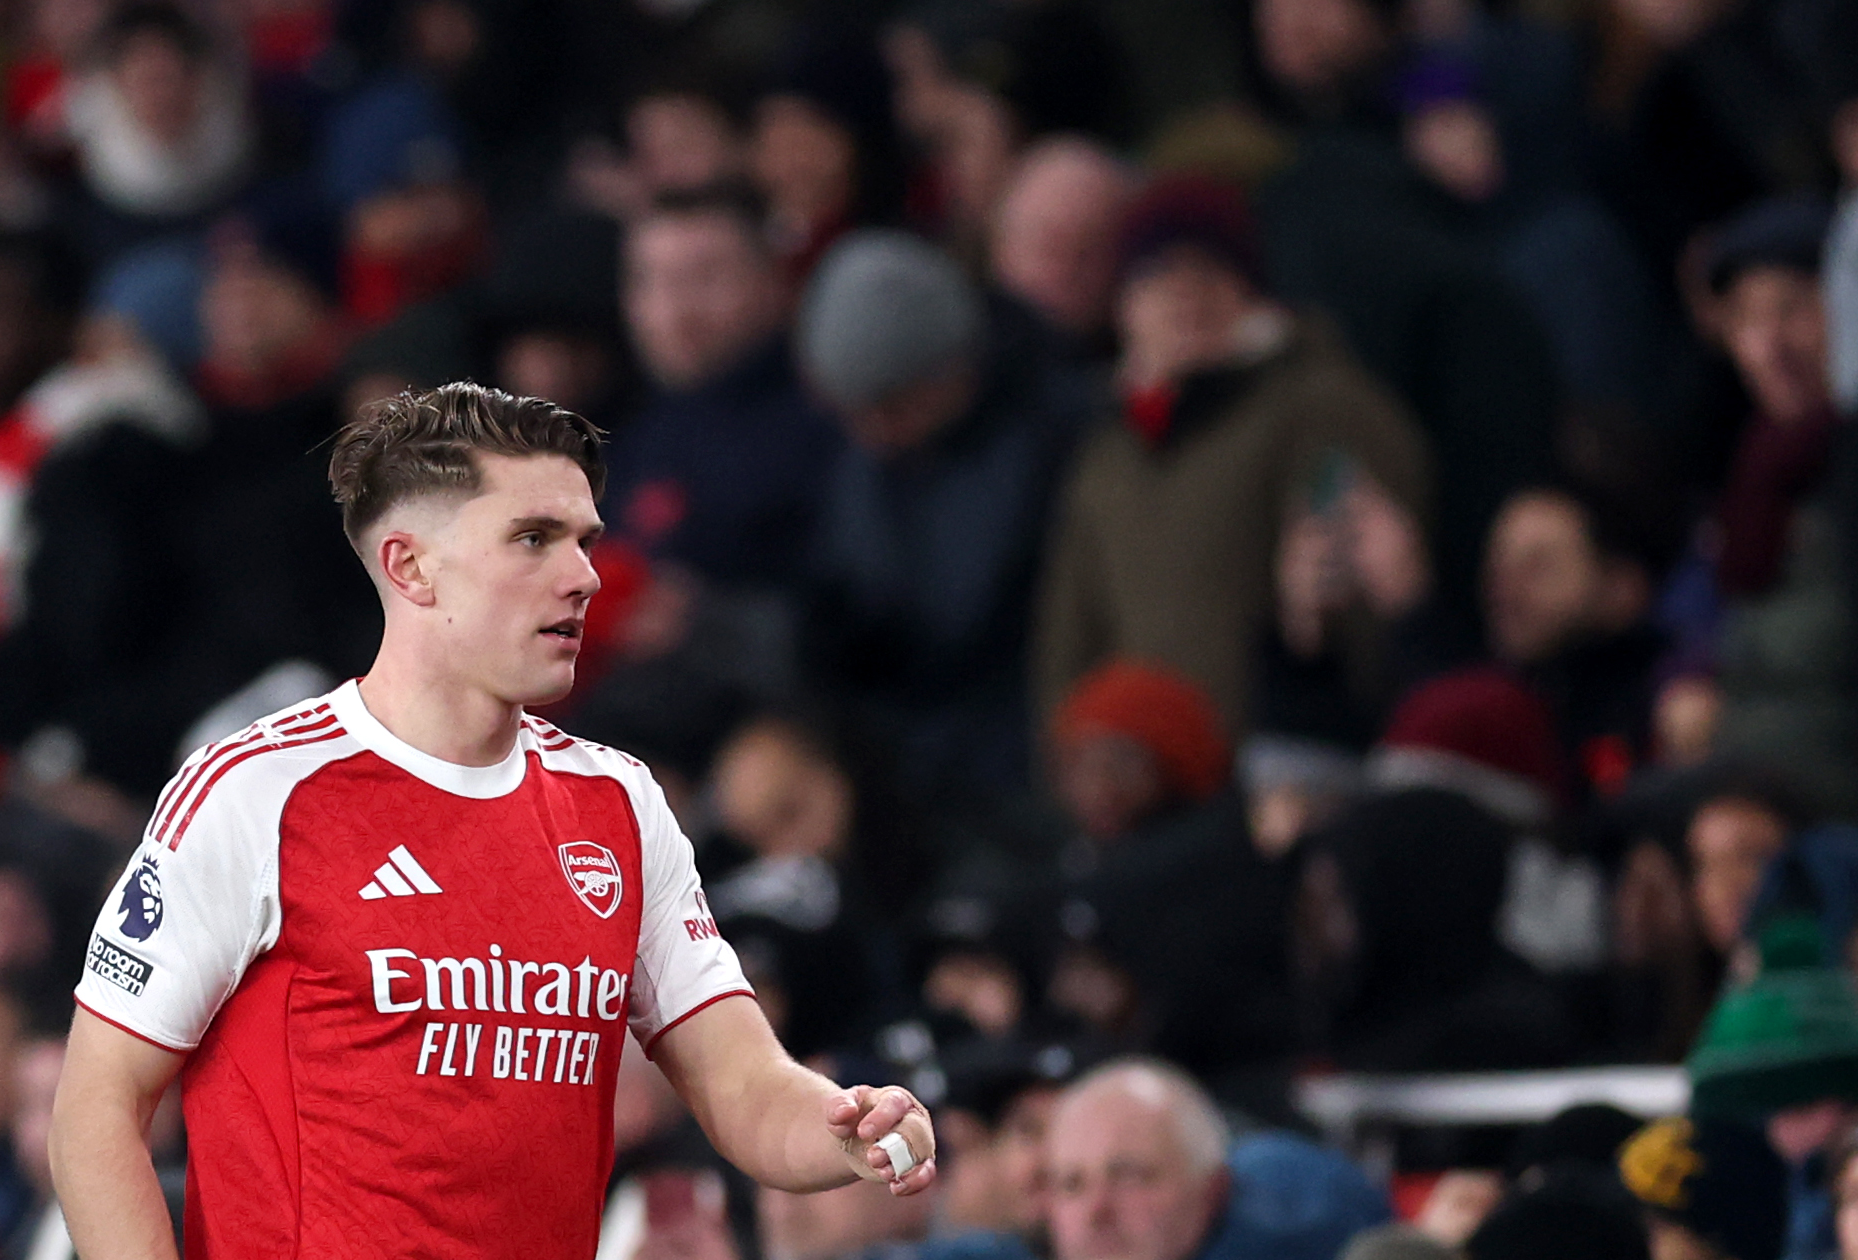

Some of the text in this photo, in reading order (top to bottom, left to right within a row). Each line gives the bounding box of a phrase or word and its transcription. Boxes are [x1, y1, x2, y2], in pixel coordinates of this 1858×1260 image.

[568, 854, 611, 869] Arsenal
[94, 959, 145, 997] racism
[102, 945, 145, 980] room
[416, 1022, 600, 1086] FLY BETTER
